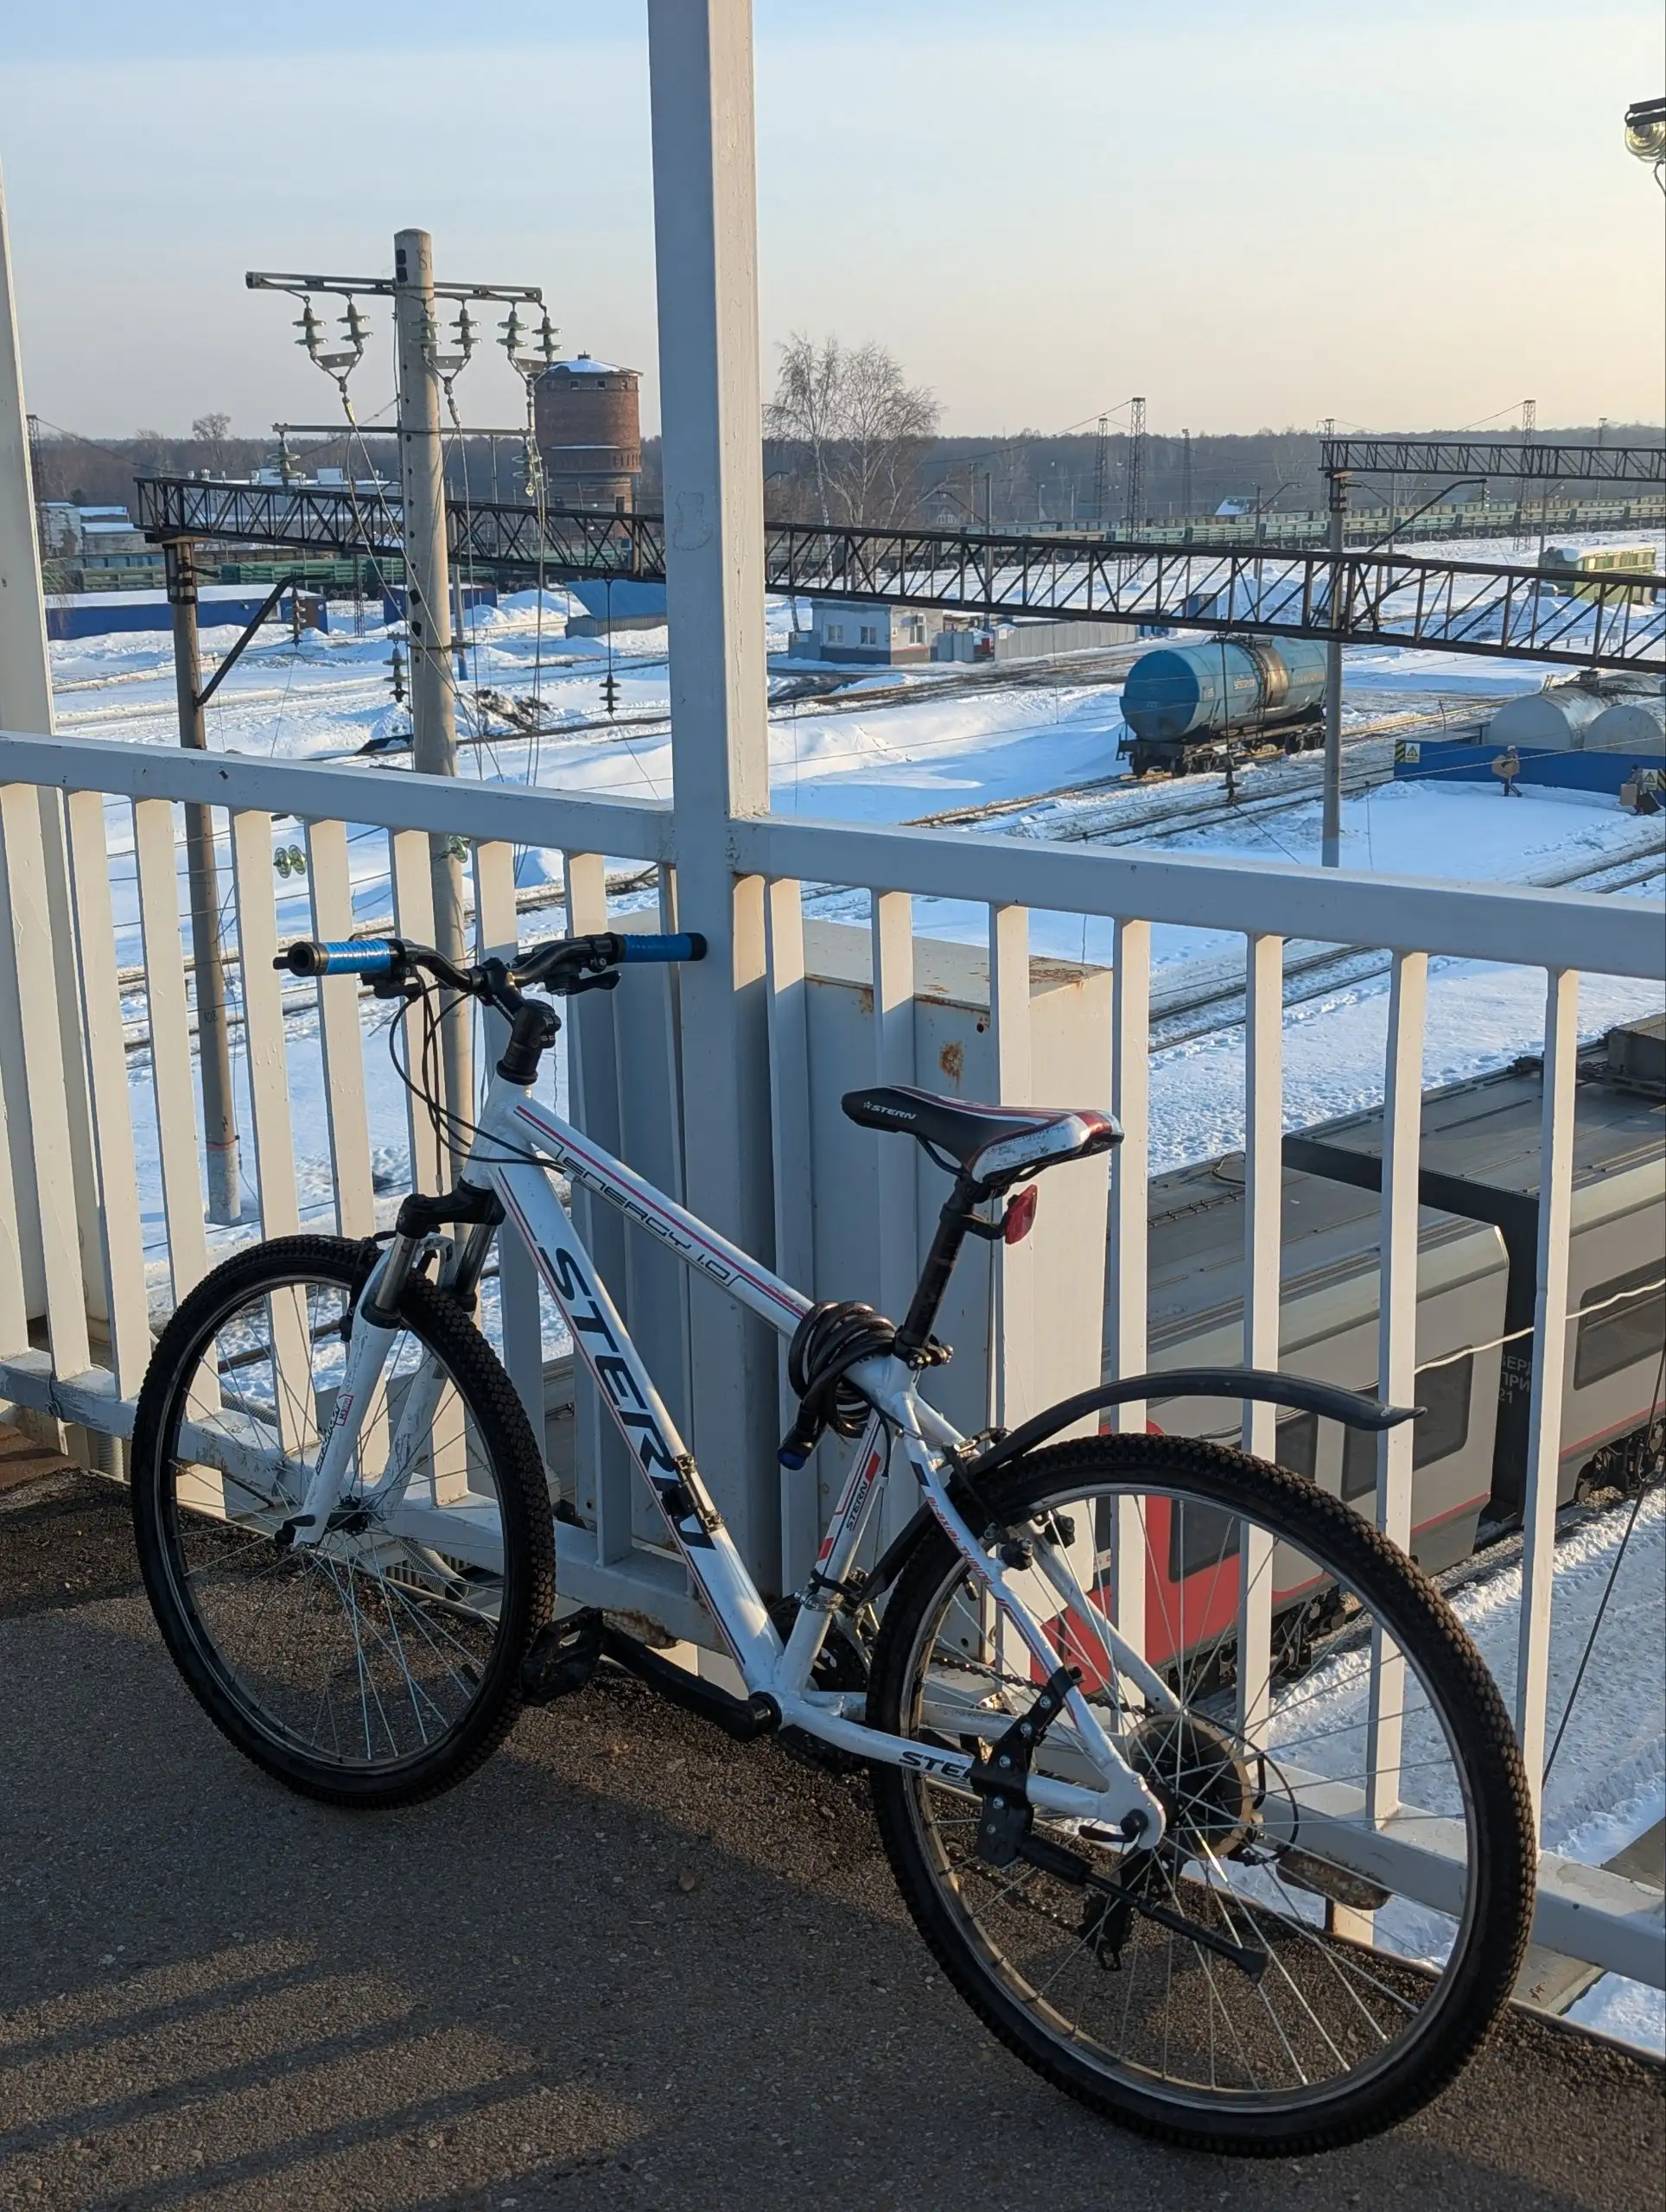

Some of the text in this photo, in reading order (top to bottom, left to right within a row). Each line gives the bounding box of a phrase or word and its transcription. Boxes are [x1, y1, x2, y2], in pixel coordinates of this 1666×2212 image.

[870, 1104, 918, 1120] STERN
[563, 1156, 693, 1250] ENERGY
[846, 1479, 868, 1532] STERN
